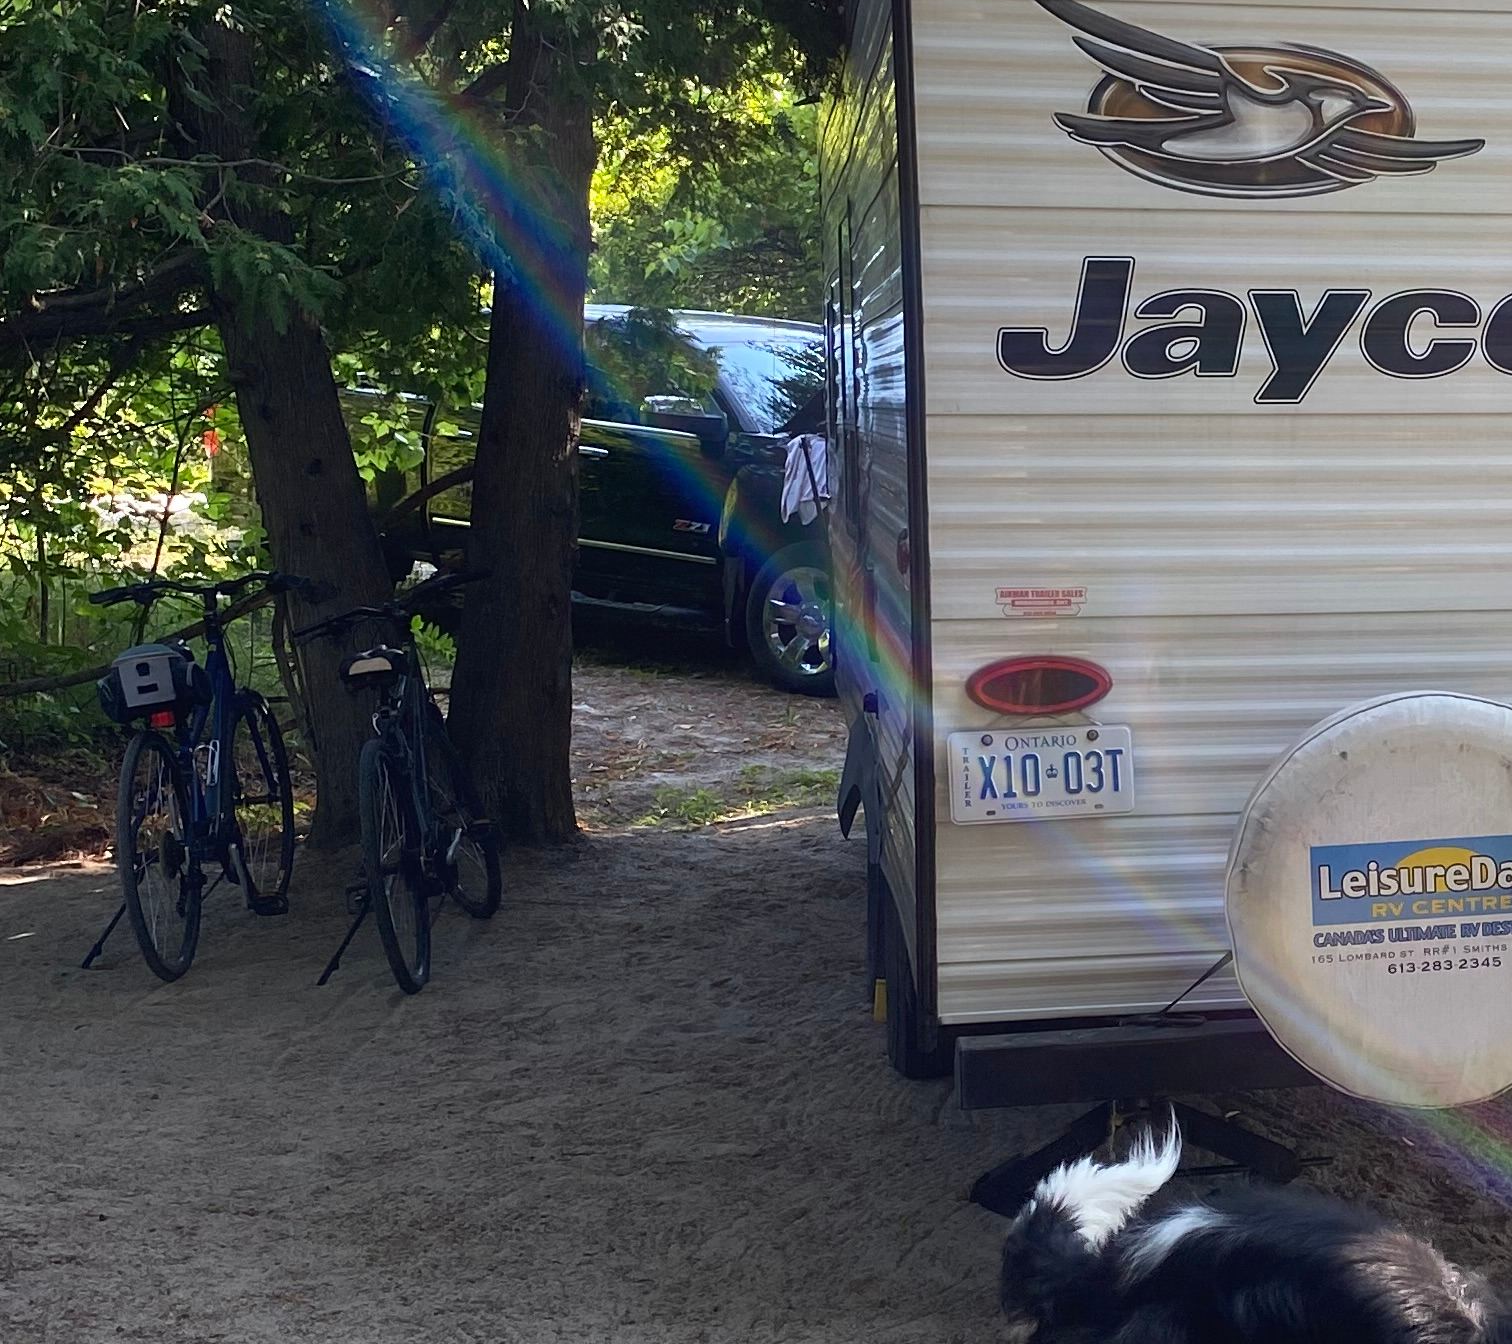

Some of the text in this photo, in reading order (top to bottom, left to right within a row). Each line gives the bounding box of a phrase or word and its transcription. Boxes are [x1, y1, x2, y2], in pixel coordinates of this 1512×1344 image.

[673, 518, 711, 534] Z71
[1005, 735, 1077, 751] ONTARIO
[962, 747, 972, 807] TRAILER
[1001, 802, 1028, 810] YOURS
[1045, 798, 1087, 807] DISCOVER
[1371, 902, 1404, 918] RV
[1313, 928, 1385, 948] CANADA'S
[1388, 924, 1457, 943] ULTIMATE
[1460, 922, 1481, 938] RV
[1311, 954, 1334, 964] 165
[1338, 951, 1396, 962] LOMBARD
[1400, 949, 1415, 958] ST
[1463, 943, 1508, 954] SMITHS
[1387, 956, 1502, 974] 613-283-2345
